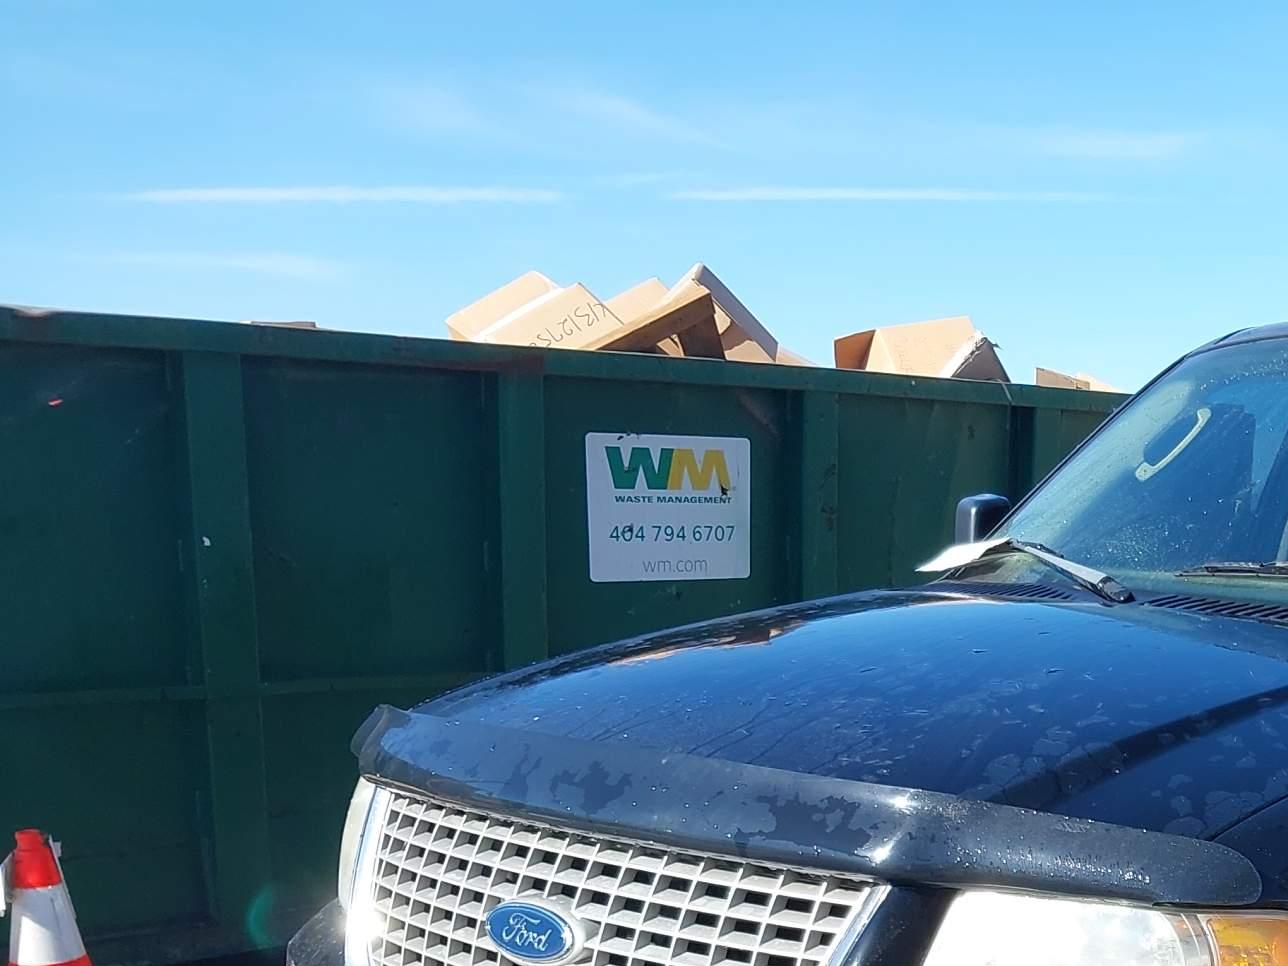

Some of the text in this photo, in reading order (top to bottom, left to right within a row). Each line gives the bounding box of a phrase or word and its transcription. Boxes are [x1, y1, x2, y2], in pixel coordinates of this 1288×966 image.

[604, 446, 731, 491] WM
[614, 495, 732, 505] WASTE MANAGEMENT
[609, 525, 735, 542] 404 794 6707
[642, 559, 708, 573] wm.com
[502, 912, 552, 951] Ford
